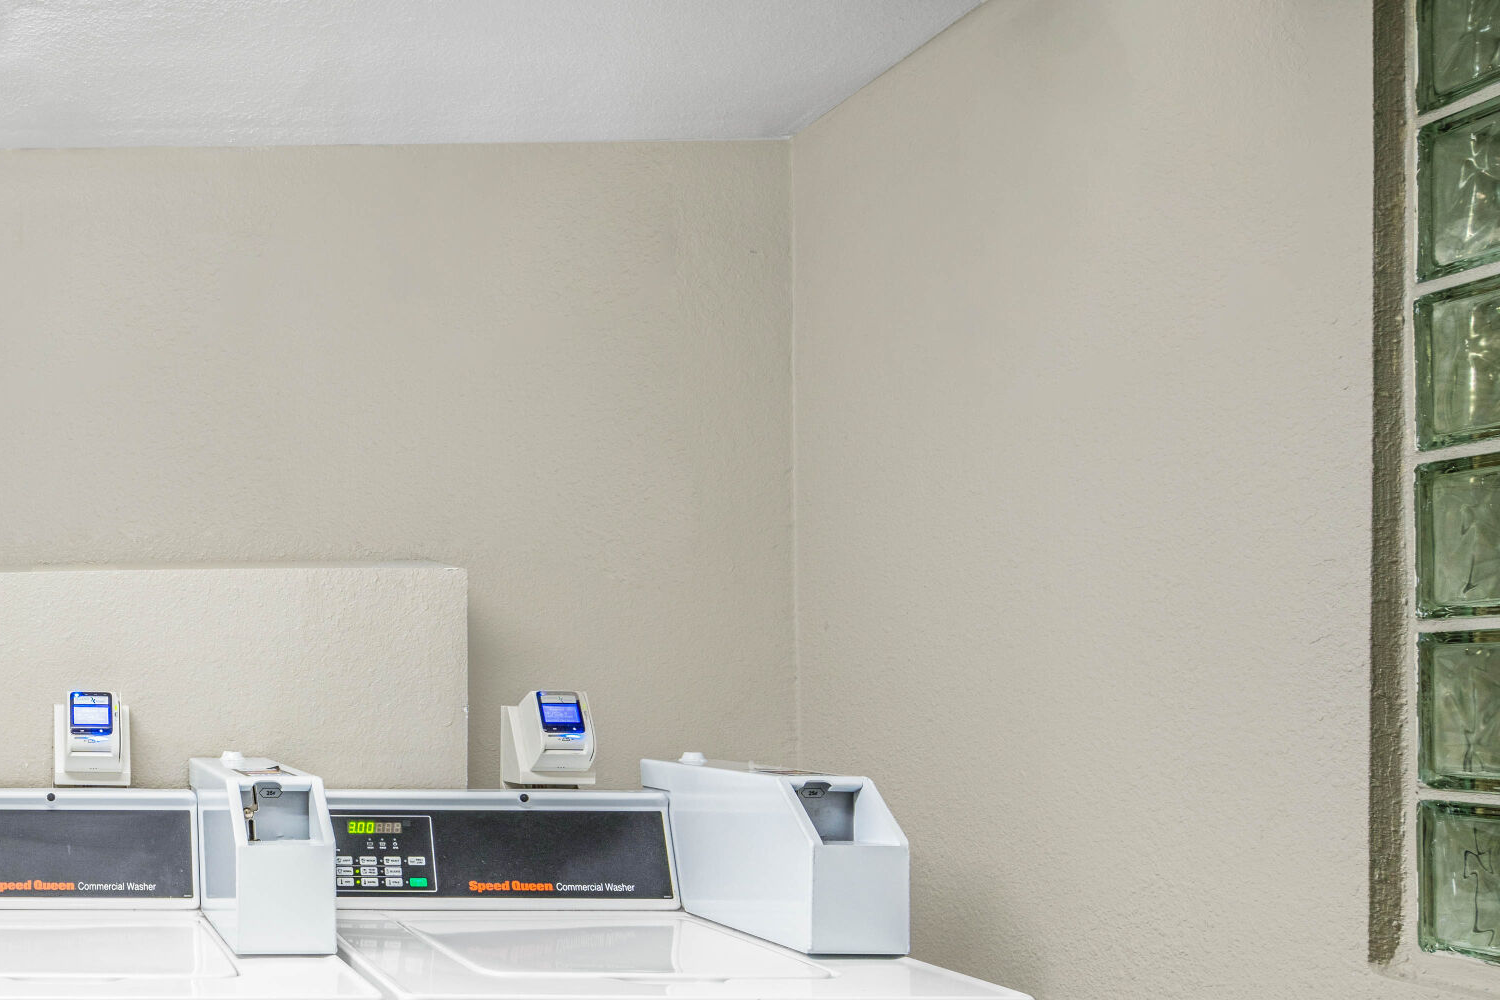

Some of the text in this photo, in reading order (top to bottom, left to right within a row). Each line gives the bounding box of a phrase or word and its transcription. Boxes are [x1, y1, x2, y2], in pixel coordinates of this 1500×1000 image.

[34, 880, 75, 891] Queen
[78, 881, 124, 891] Commercial
[127, 882, 156, 891] Washer
[468, 880, 635, 893] Speed Queen Commercial Washer
